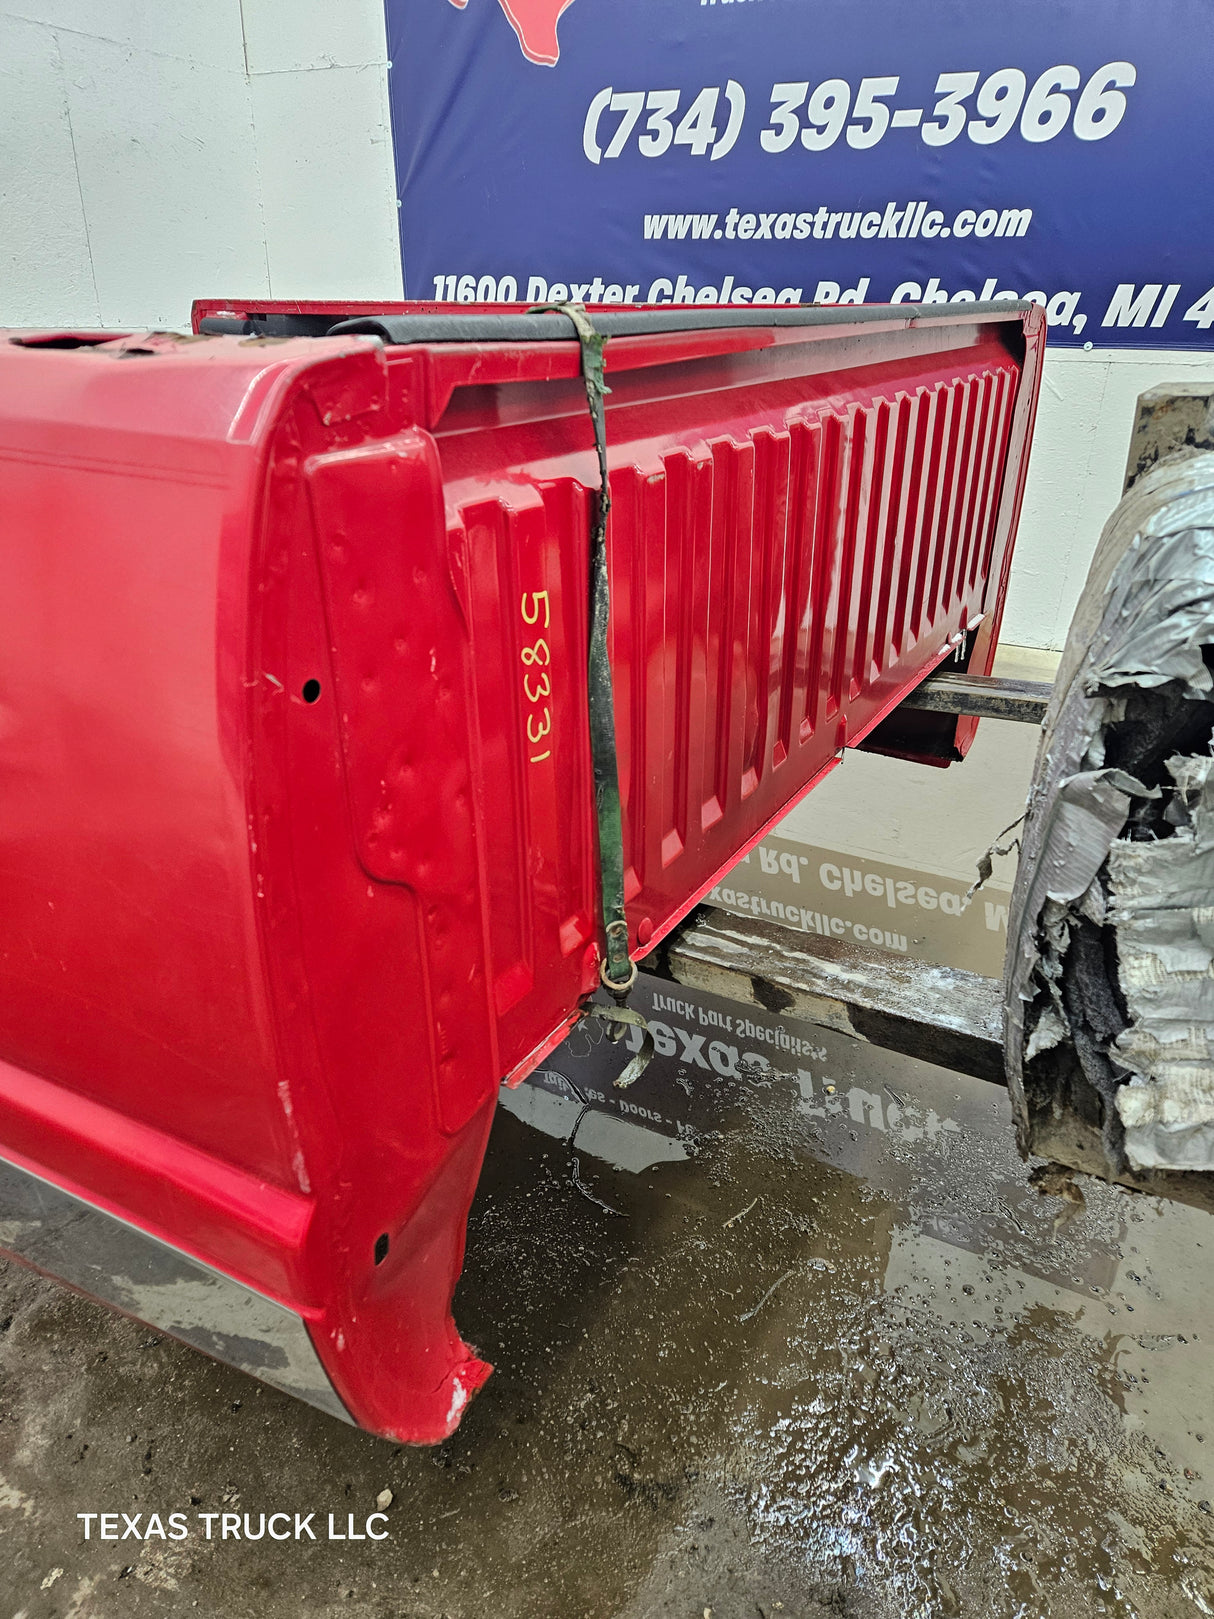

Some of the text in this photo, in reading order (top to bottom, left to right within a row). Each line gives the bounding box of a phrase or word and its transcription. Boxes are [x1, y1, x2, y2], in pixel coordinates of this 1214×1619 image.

[582, 61, 1138, 164] (734) 395-3966
[643, 200, 1033, 240] www.texastruckllc.com
[433, 275, 518, 303] 11600
[526, 276, 640, 303] Dexter
[1101, 284, 1182, 328] MI
[521, 590, 551, 763] 58331
